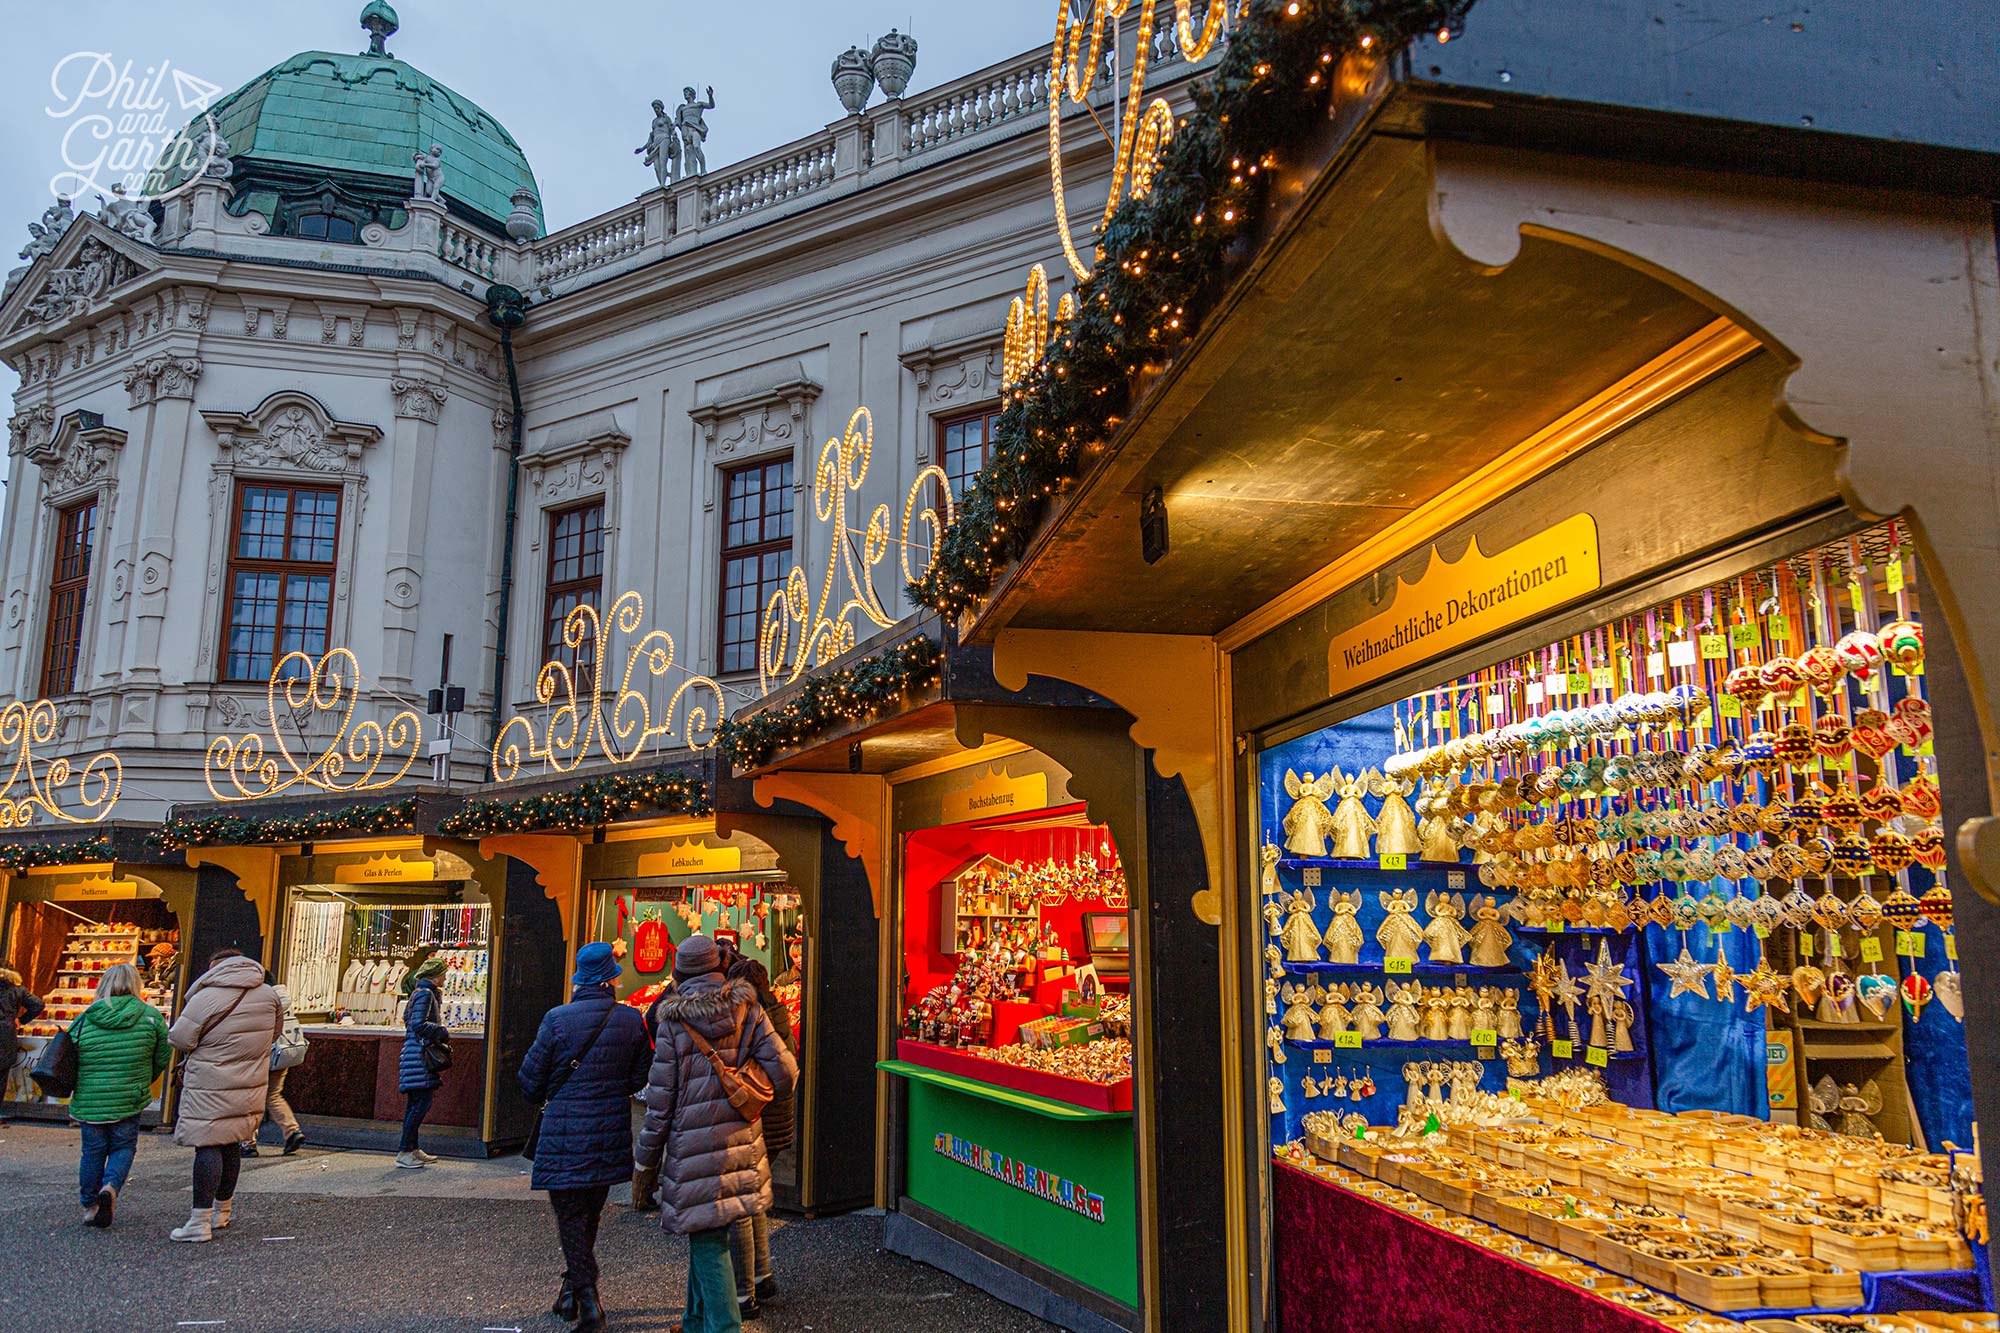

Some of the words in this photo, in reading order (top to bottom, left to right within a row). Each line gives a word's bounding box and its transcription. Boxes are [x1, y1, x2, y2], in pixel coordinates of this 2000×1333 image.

[1343, 610, 1443, 670] Weihnachtliche
[1446, 554, 1568, 626] Dekorationen
[1733, 632, 1754, 643] €12
[1704, 643, 1722, 654] €12
[968, 793, 1014, 810] Buchstabenzug
[671, 857, 704, 867] Lebkuchen
[364, 869, 377, 877] Glas
[378, 869, 383, 877] &
[384, 868, 402, 877] Perlen
[1390, 961, 1405, 970] €15
[1339, 1035, 1355, 1044] €12
[1476, 1033, 1492, 1043] €10
[945, 1133, 1087, 1208] BUCHSTABENZUG
